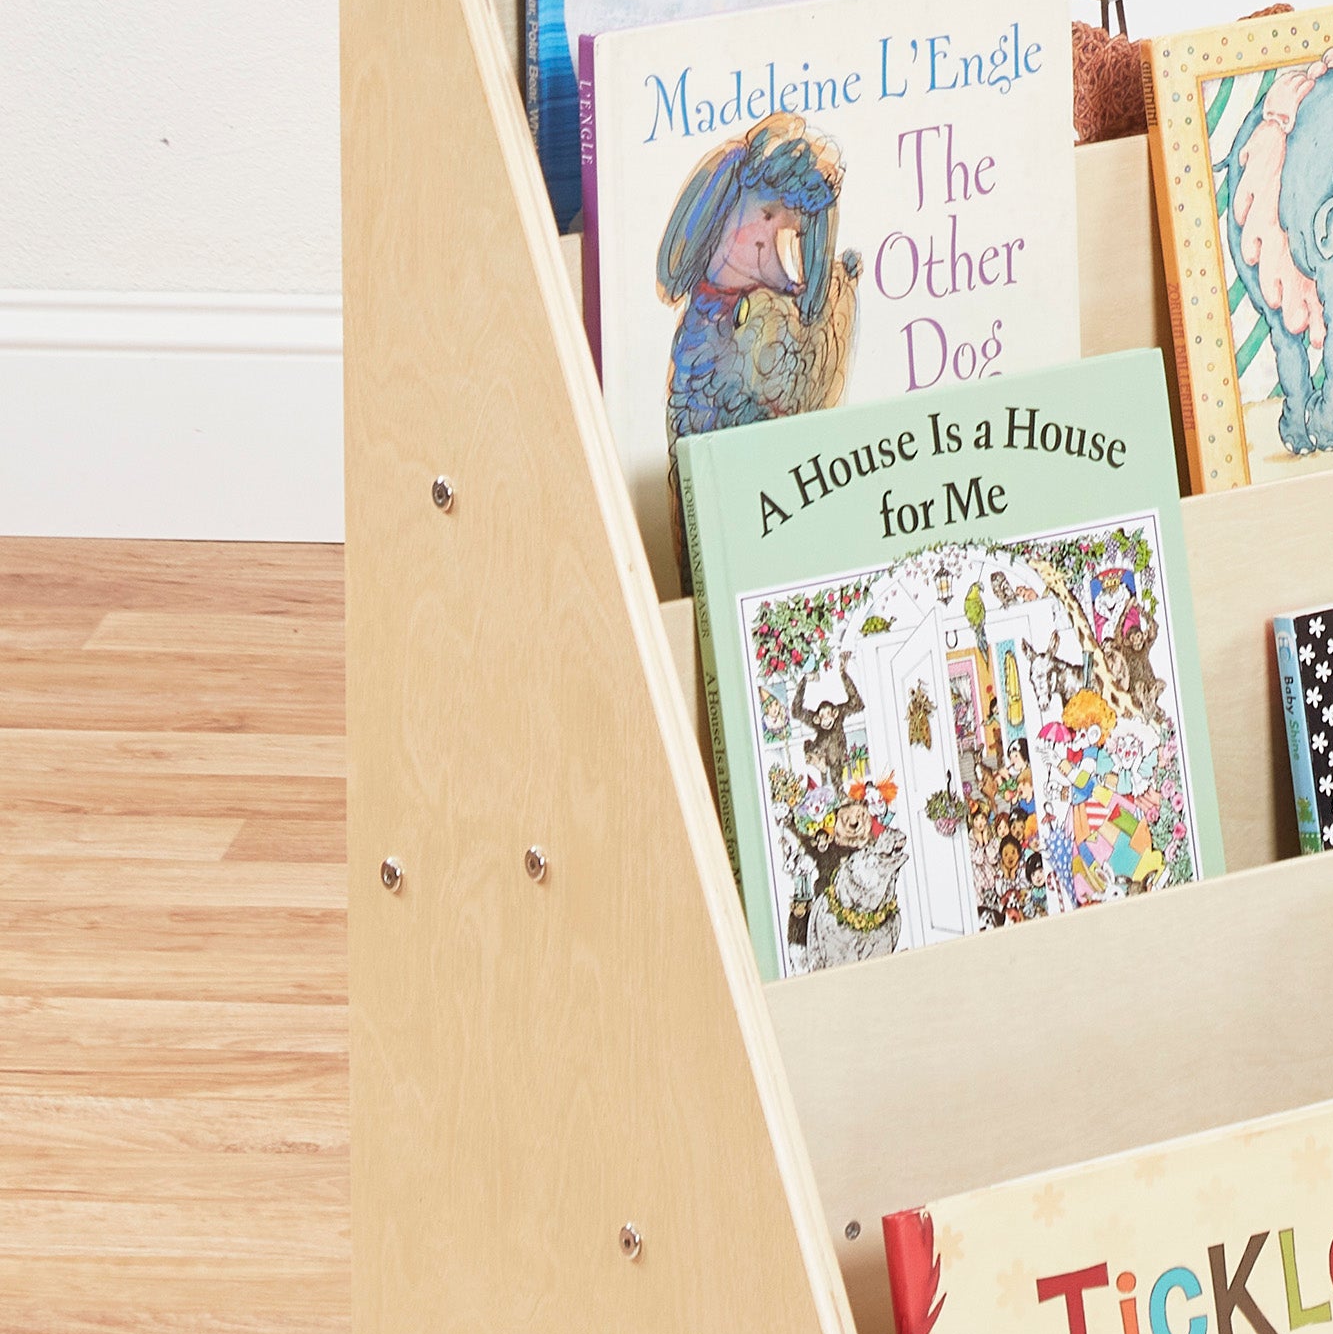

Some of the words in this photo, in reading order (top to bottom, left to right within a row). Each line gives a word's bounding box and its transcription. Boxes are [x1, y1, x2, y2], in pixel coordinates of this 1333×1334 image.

[579, 81, 594, 166] L'ENGLE
[643, 62, 863, 144] Madeleine
[878, 23, 1043, 102] L'Engle
[898, 123, 997, 212] The
[875, 215, 1025, 300] Other
[900, 317, 1004, 393] Dog
[756, 491, 792, 537] A
[787, 429, 918, 510] House
[928, 412, 962, 456] Is
[973, 424, 992, 451] a
[1004, 407, 1127, 469] House
[880, 488, 936, 539] for
[942, 476, 1008, 527] Me
[1284, 676, 1297, 715] Baby
[707, 691, 723, 746] House
[718, 778, 733, 834] House
[1289, 719, 1300, 761] Shine
